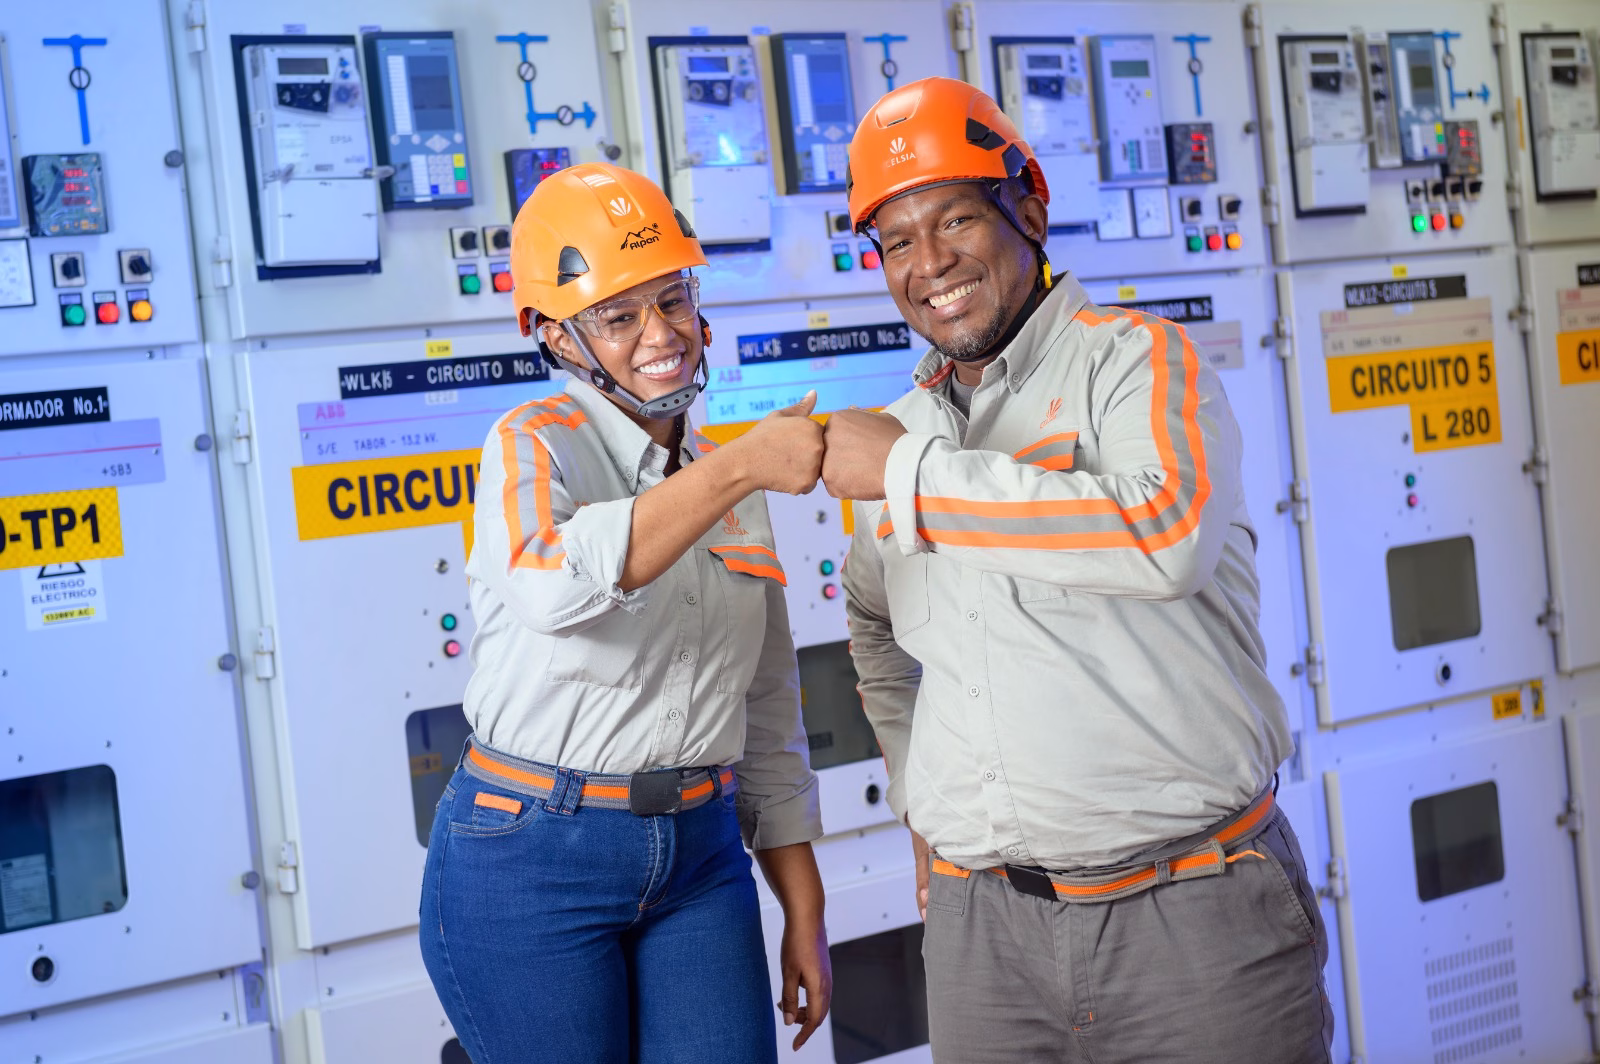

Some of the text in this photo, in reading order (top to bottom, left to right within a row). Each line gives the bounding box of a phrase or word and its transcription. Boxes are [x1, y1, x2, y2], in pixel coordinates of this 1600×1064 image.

[1429, 279, 1438, 298] 5
[807, 331, 870, 352] CIRCUITO
[877, 327, 908, 346] No.2
[426, 361, 503, 384] CIRCUITO
[513, 359, 547, 376] No.1
[1351, 353, 1492, 398] CIRCUITO 5
[0, 395, 104, 422] RMADOR No.1
[316, 402, 346, 420] ABB
[1421, 407, 1491, 441] L 280
[317, 442, 338, 456] S/E
[353, 437, 387, 451] TABOR
[401, 433, 421, 446] 13.2
[328, 463, 480, 520] CIRCUI
[0, 503, 101, 555] -TP1
[31, 587, 97, 604] ELECTRICO
[41, 578, 85, 592] RIESGO
